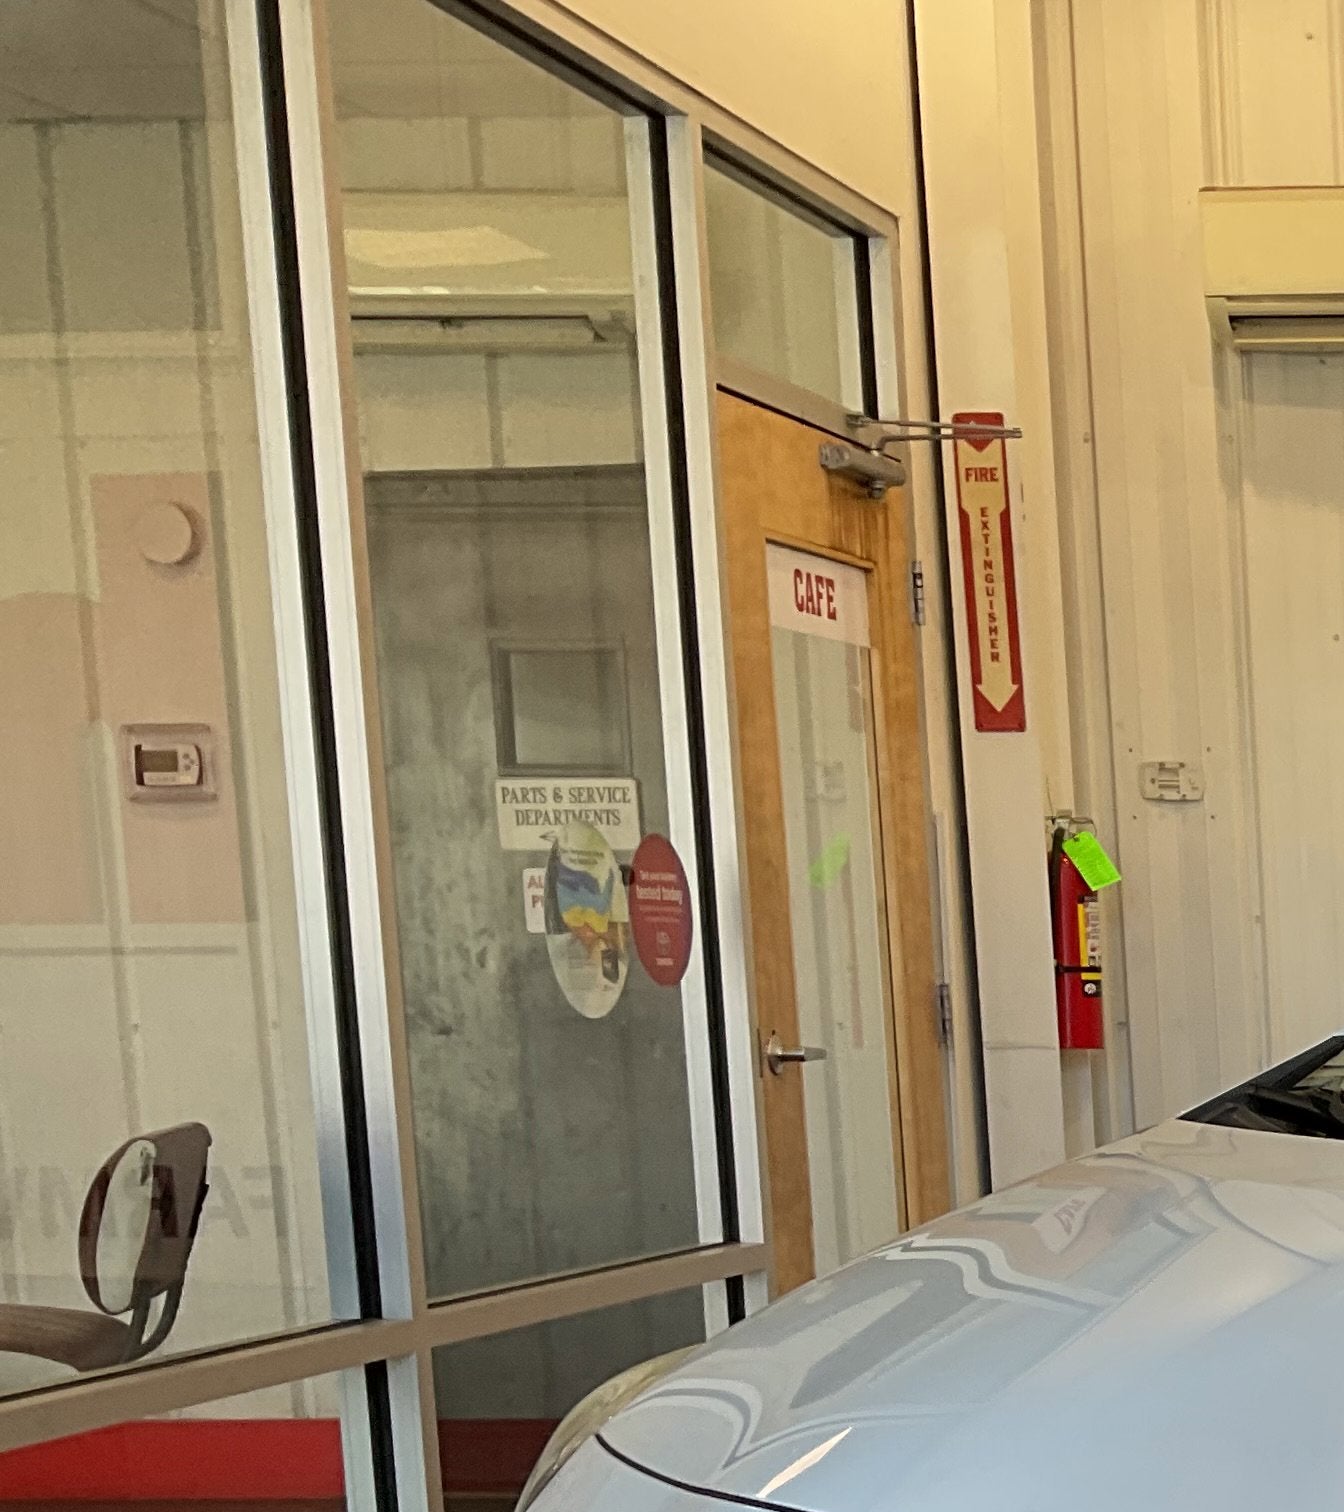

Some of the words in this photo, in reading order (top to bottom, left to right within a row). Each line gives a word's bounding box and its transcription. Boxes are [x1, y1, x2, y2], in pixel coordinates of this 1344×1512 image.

[965, 466, 999, 483] FIRE
[979, 506, 1000, 663] EXTINGUISHER
[794, 568, 837, 621] CAFE
[500, 786, 547, 804] PARTS
[553, 786, 563, 803] &
[568, 786, 631, 804] SERVICE
[515, 809, 621, 826] DEPARTMENTS
